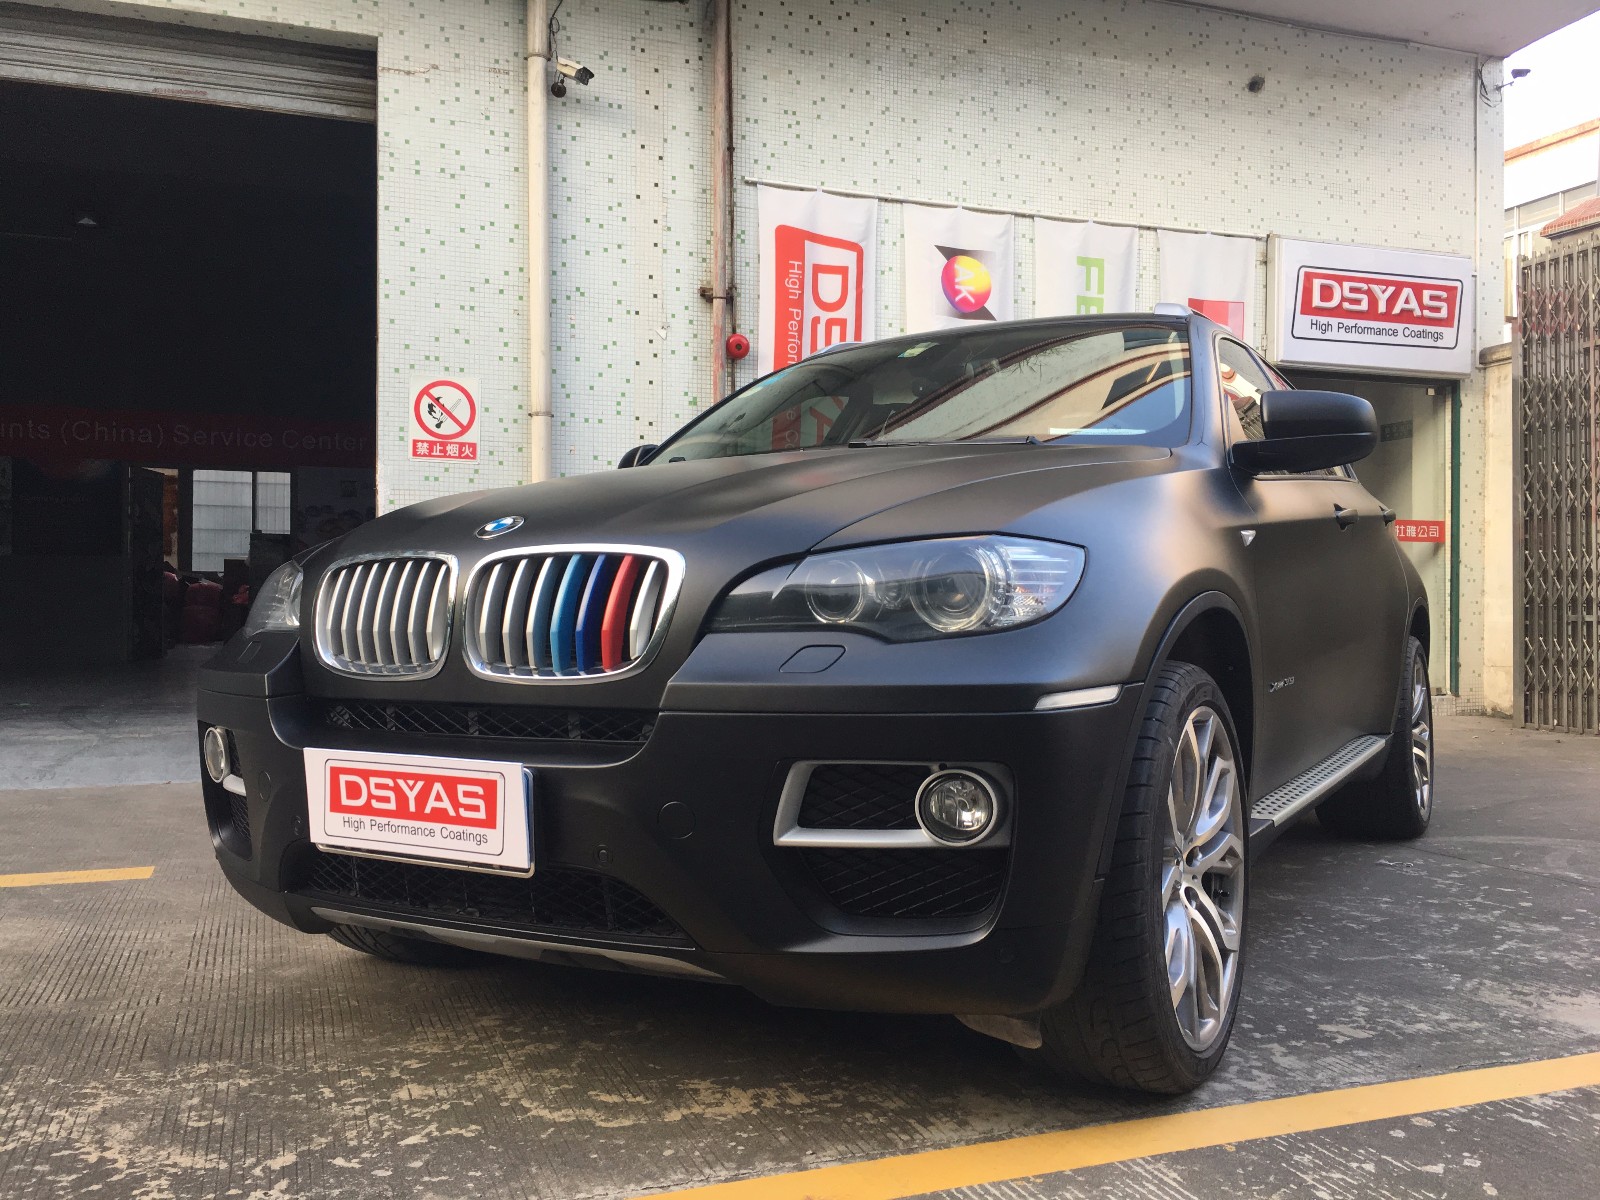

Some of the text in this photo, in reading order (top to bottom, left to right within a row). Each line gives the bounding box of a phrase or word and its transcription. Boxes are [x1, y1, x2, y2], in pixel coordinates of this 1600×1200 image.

[785, 260, 802, 299] High
[954, 264, 976, 304] AK
[1312, 278, 1448, 320] DSYAS
[1310, 319, 1444, 342] High Performance Coatings
[60, 418, 165, 448] (China)
[173, 422, 273, 449] Service
[282, 429, 367, 452] Center
[415, 441, 474, 457] 禁止烟火
[338, 773, 487, 820] DSYAS
[342, 816, 488, 846] High Performance Coatings
